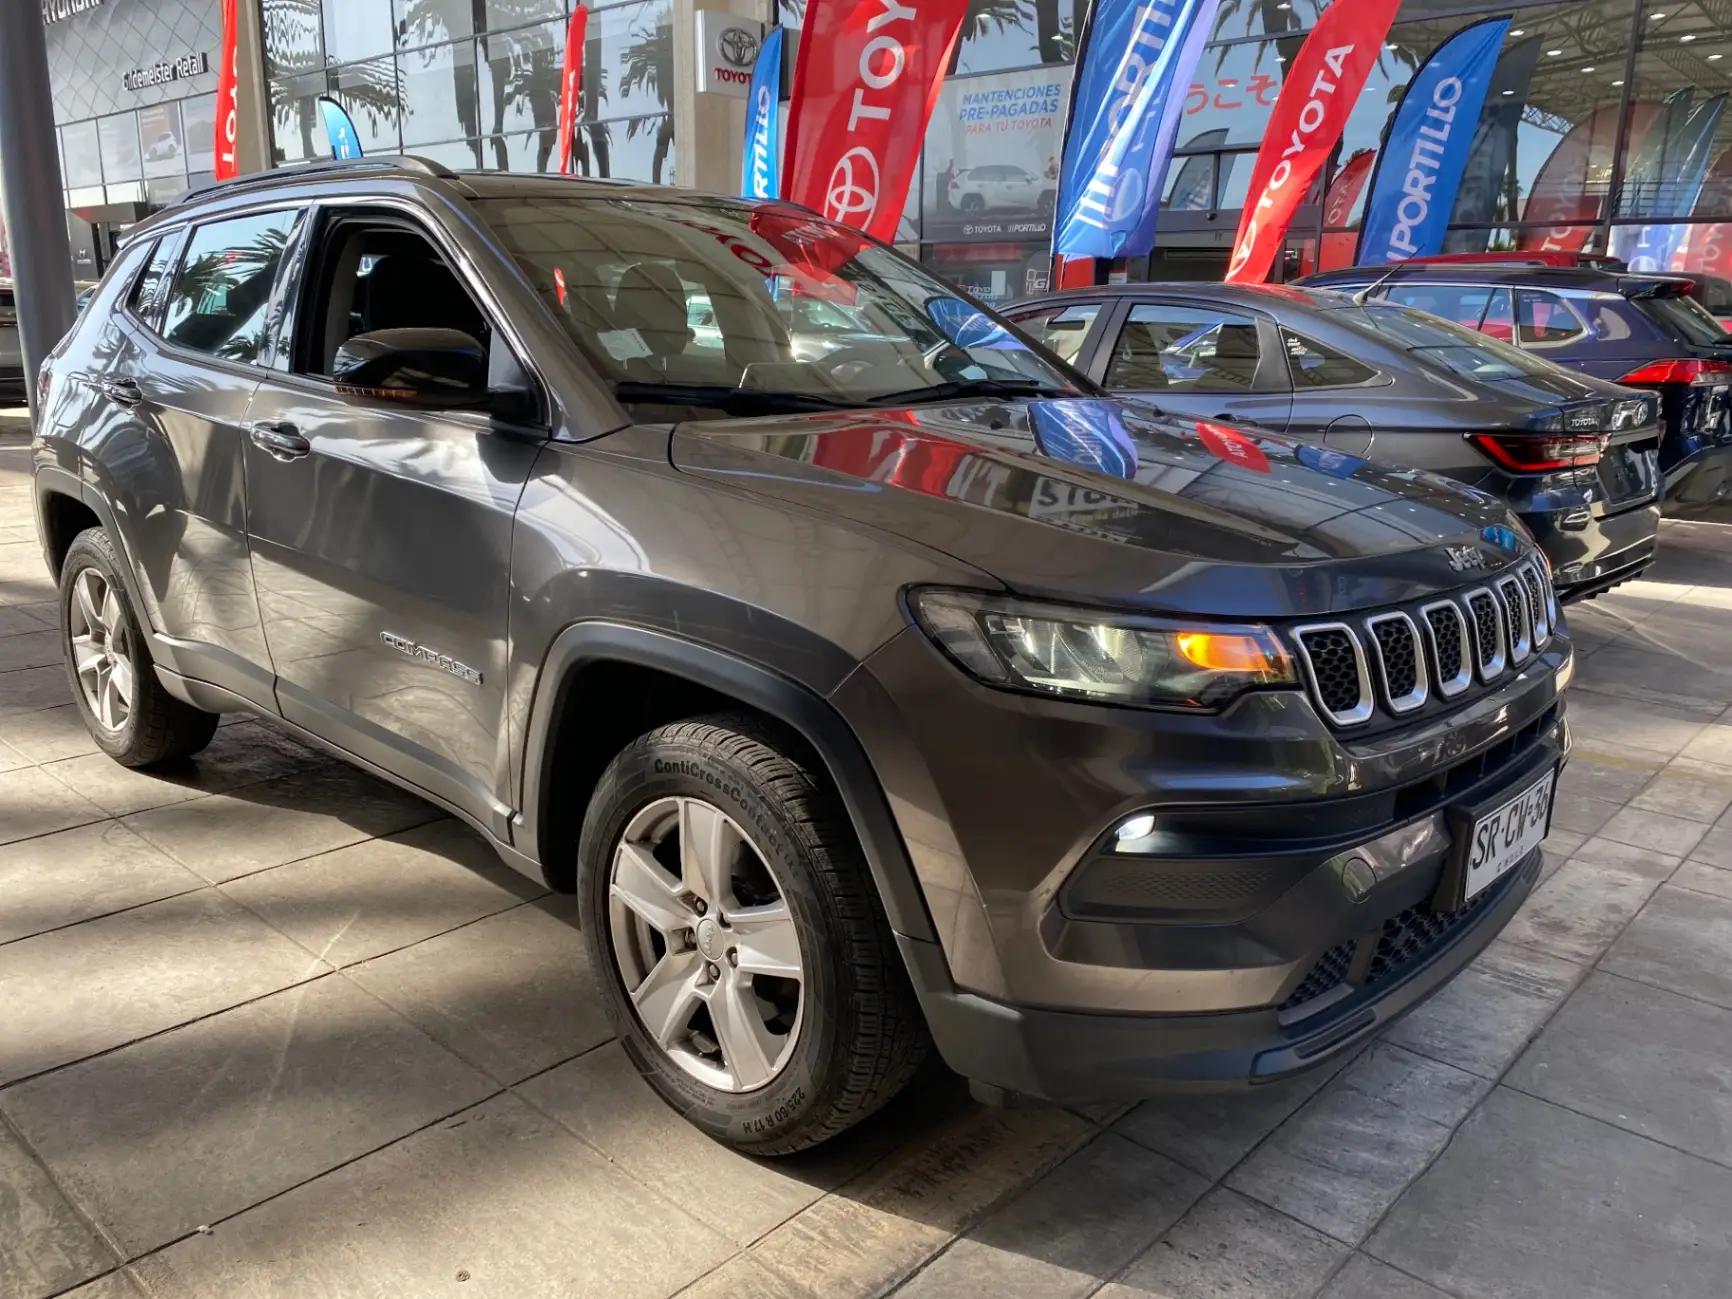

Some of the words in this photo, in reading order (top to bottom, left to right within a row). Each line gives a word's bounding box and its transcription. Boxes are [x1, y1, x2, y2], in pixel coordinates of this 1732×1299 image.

[122, 60, 175, 90] Gildemeister
[176, 51, 206, 78] Retail
[960, 99, 1060, 120] PRE-PAGADAS
[963, 84, 1062, 105] MANTENCIONES
[1186, 75, 1278, 115] うこそ
[967, 122, 992, 135] PARA
[1012, 117, 1053, 131] TOYOTA
[1259, 43, 1355, 209] TOYOTA
[1389, 77, 1463, 254] PORTILLO
[974, 225, 1002, 233] TOYOTA
